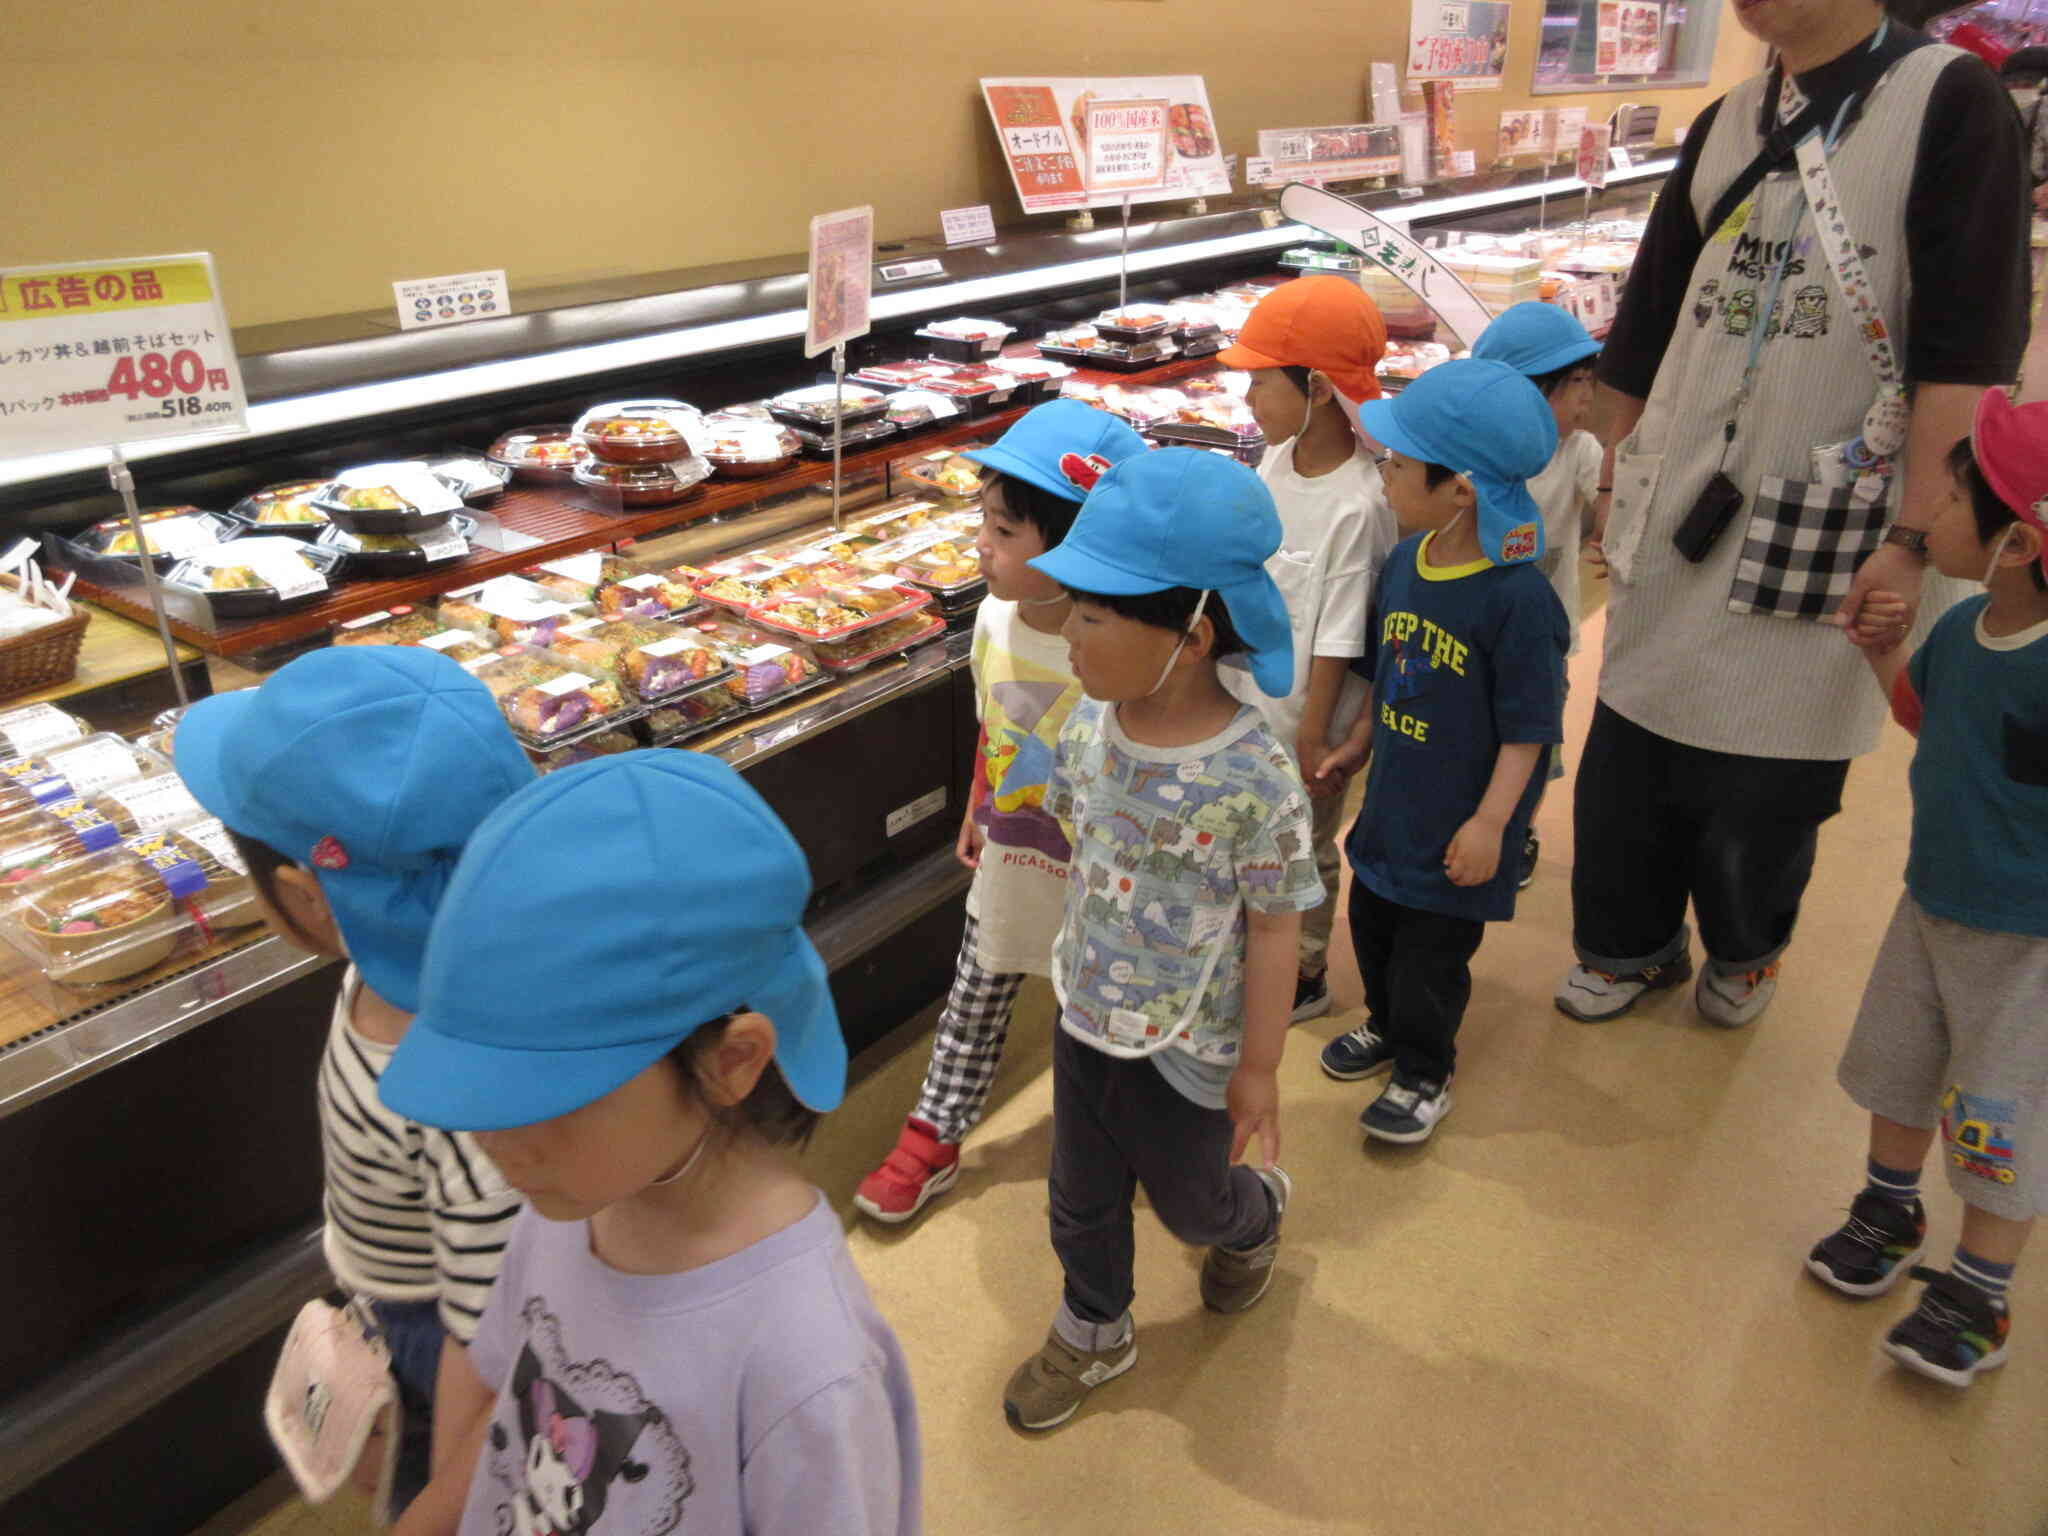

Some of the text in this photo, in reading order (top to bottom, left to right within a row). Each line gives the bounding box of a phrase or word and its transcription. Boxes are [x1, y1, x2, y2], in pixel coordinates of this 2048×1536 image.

[1010, 130, 1063, 150] オードブル
[18, 269, 163, 311] 広告の品
[1423, 619, 1469, 677] THE
[1003, 853, 1068, 879] PICASSO
